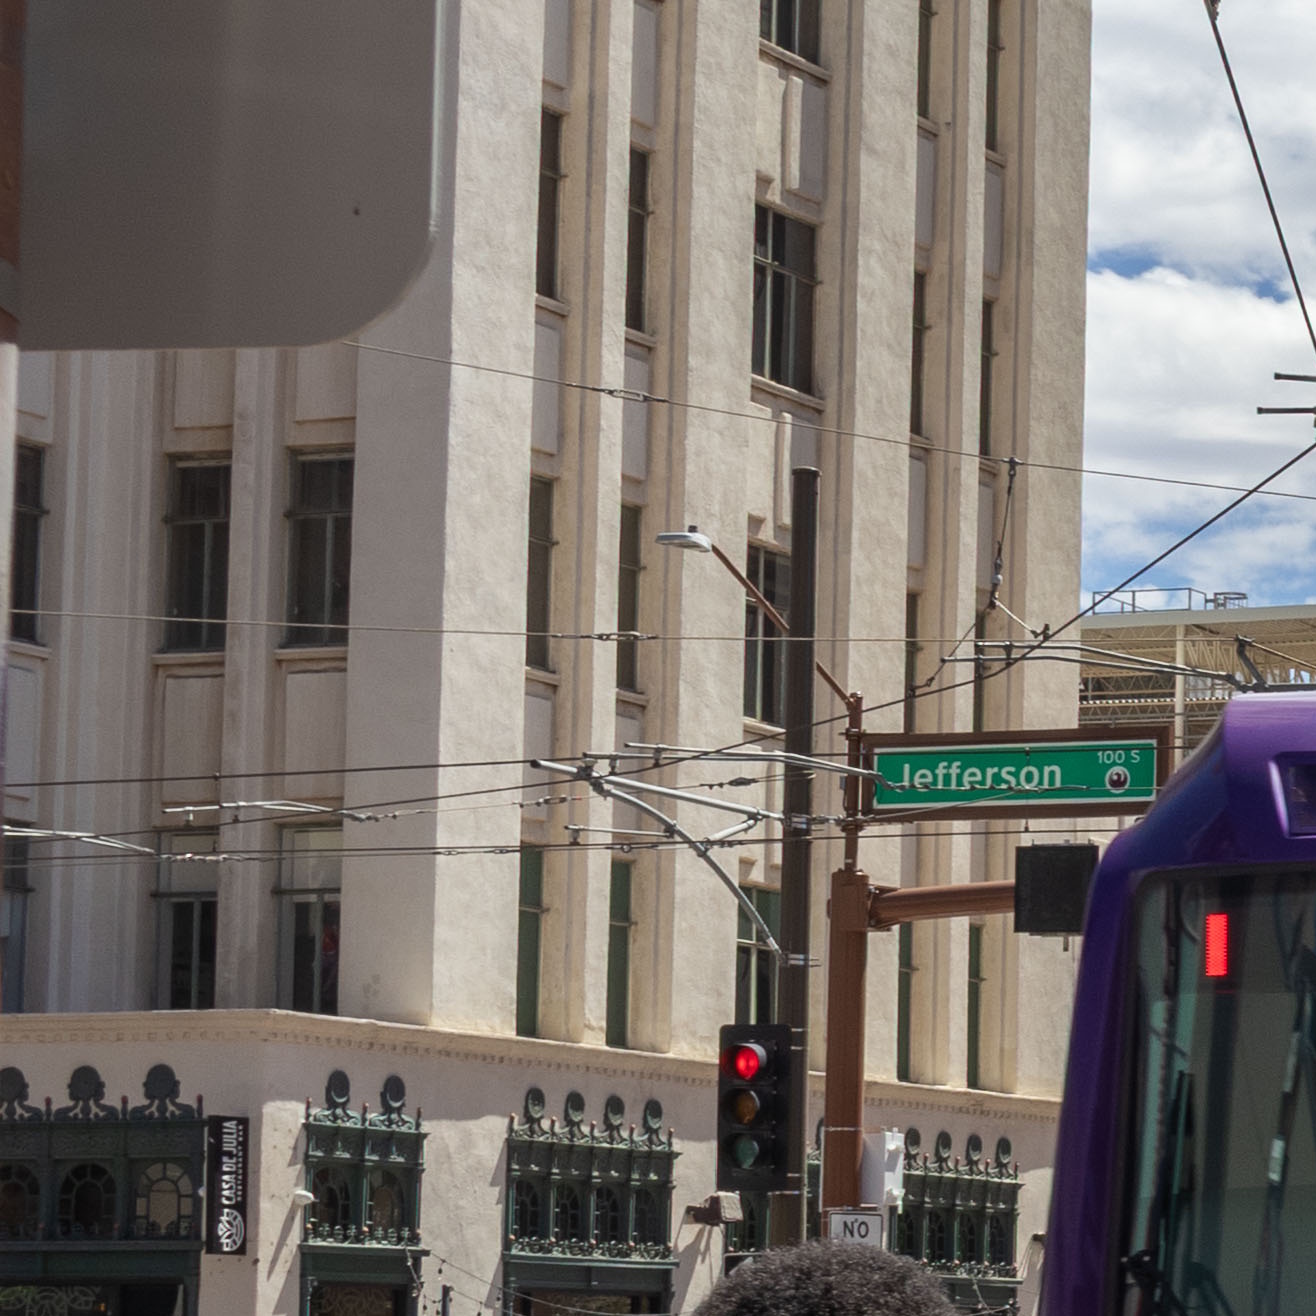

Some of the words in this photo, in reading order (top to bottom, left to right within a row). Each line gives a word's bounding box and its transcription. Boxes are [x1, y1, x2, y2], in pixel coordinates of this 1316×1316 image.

[1097, 750, 1125, 764] 100
[1131, 749, 1141, 763] S
[900, 761, 1062, 791] Jefferson
[222, 1120, 238, 1154] JULIA
[221, 1155, 236, 1172] DE
[221, 1174, 236, 1205] CASA
[843, 1220, 870, 1239] NO
